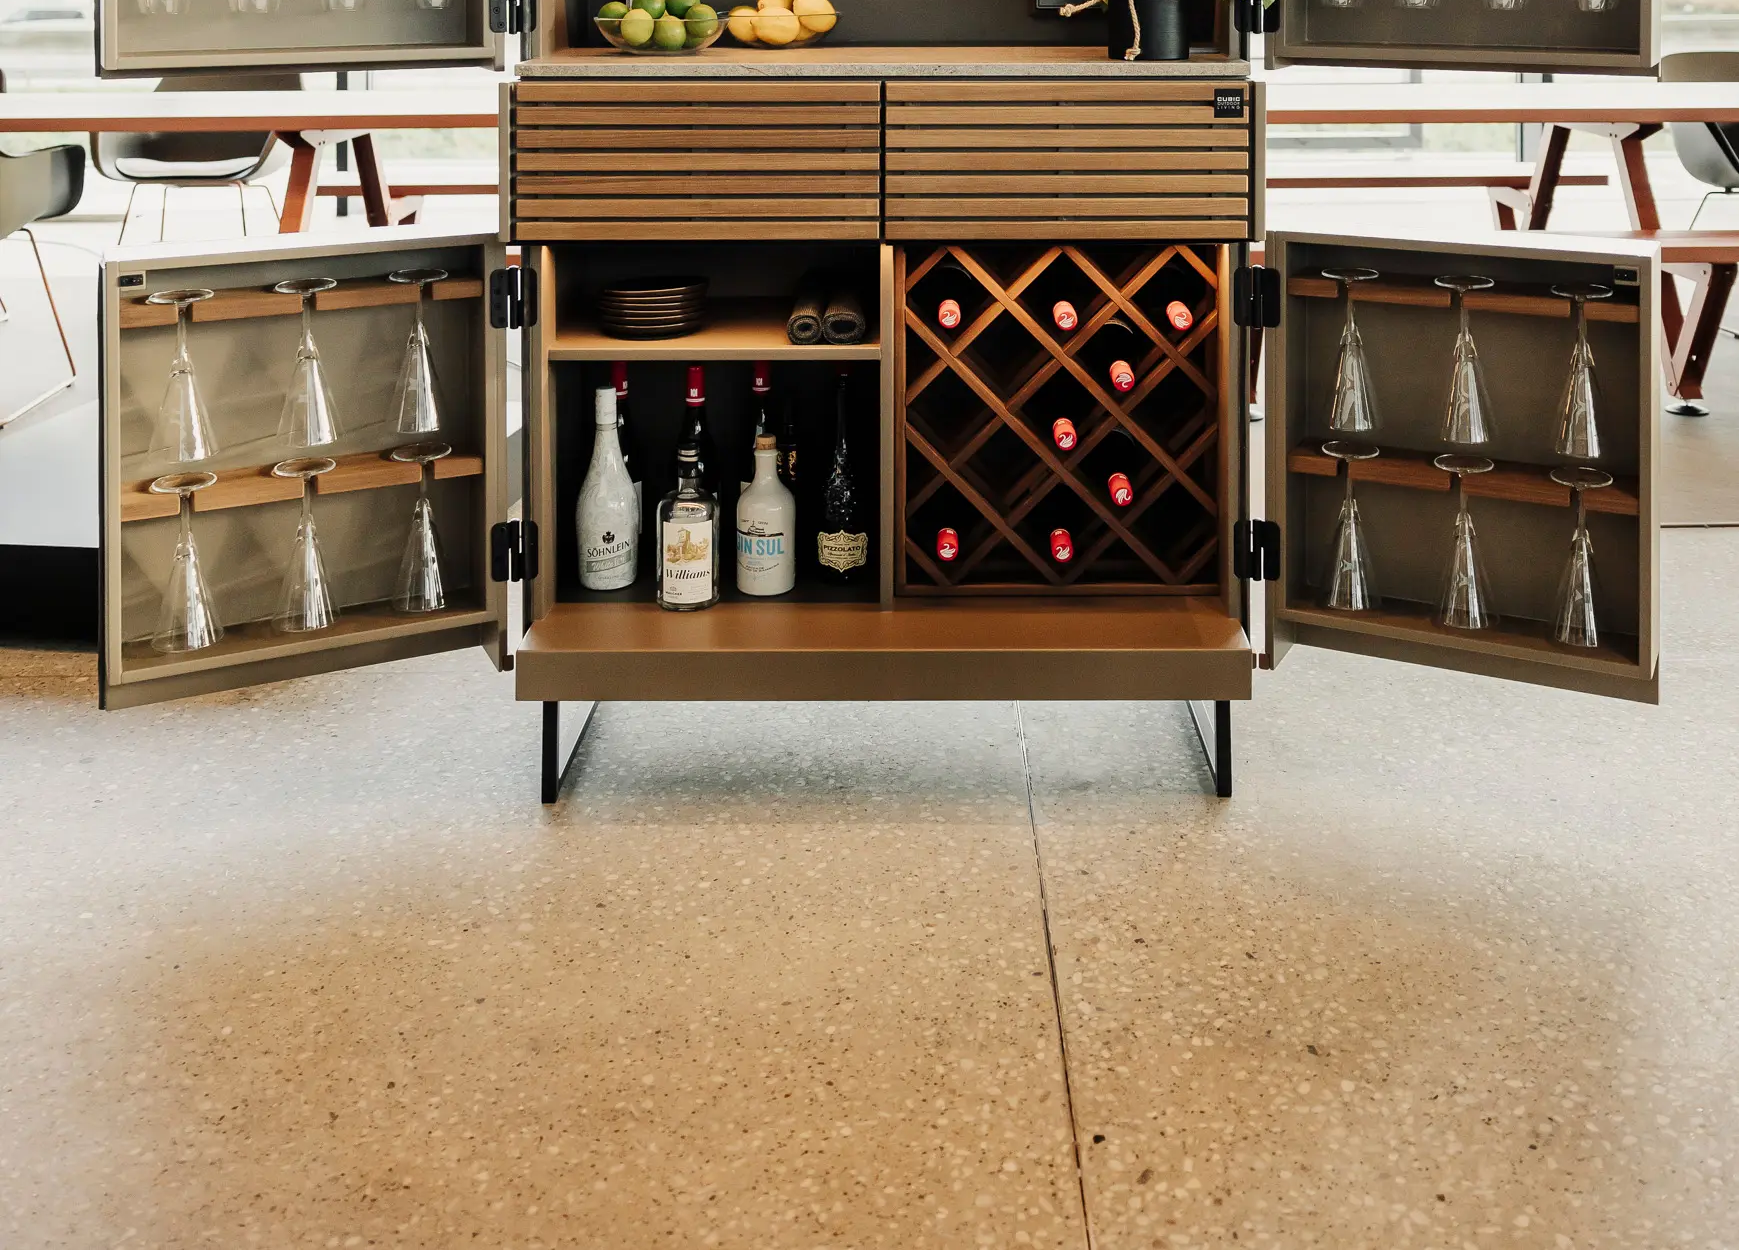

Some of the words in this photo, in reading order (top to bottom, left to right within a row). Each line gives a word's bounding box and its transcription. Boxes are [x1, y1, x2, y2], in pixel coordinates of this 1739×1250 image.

[587, 539, 631, 558] SÖHNLEIN
[756, 537, 784, 556] SUL
[823, 544, 861, 552] PIZZOLATO
[665, 568, 711, 580] Williams
